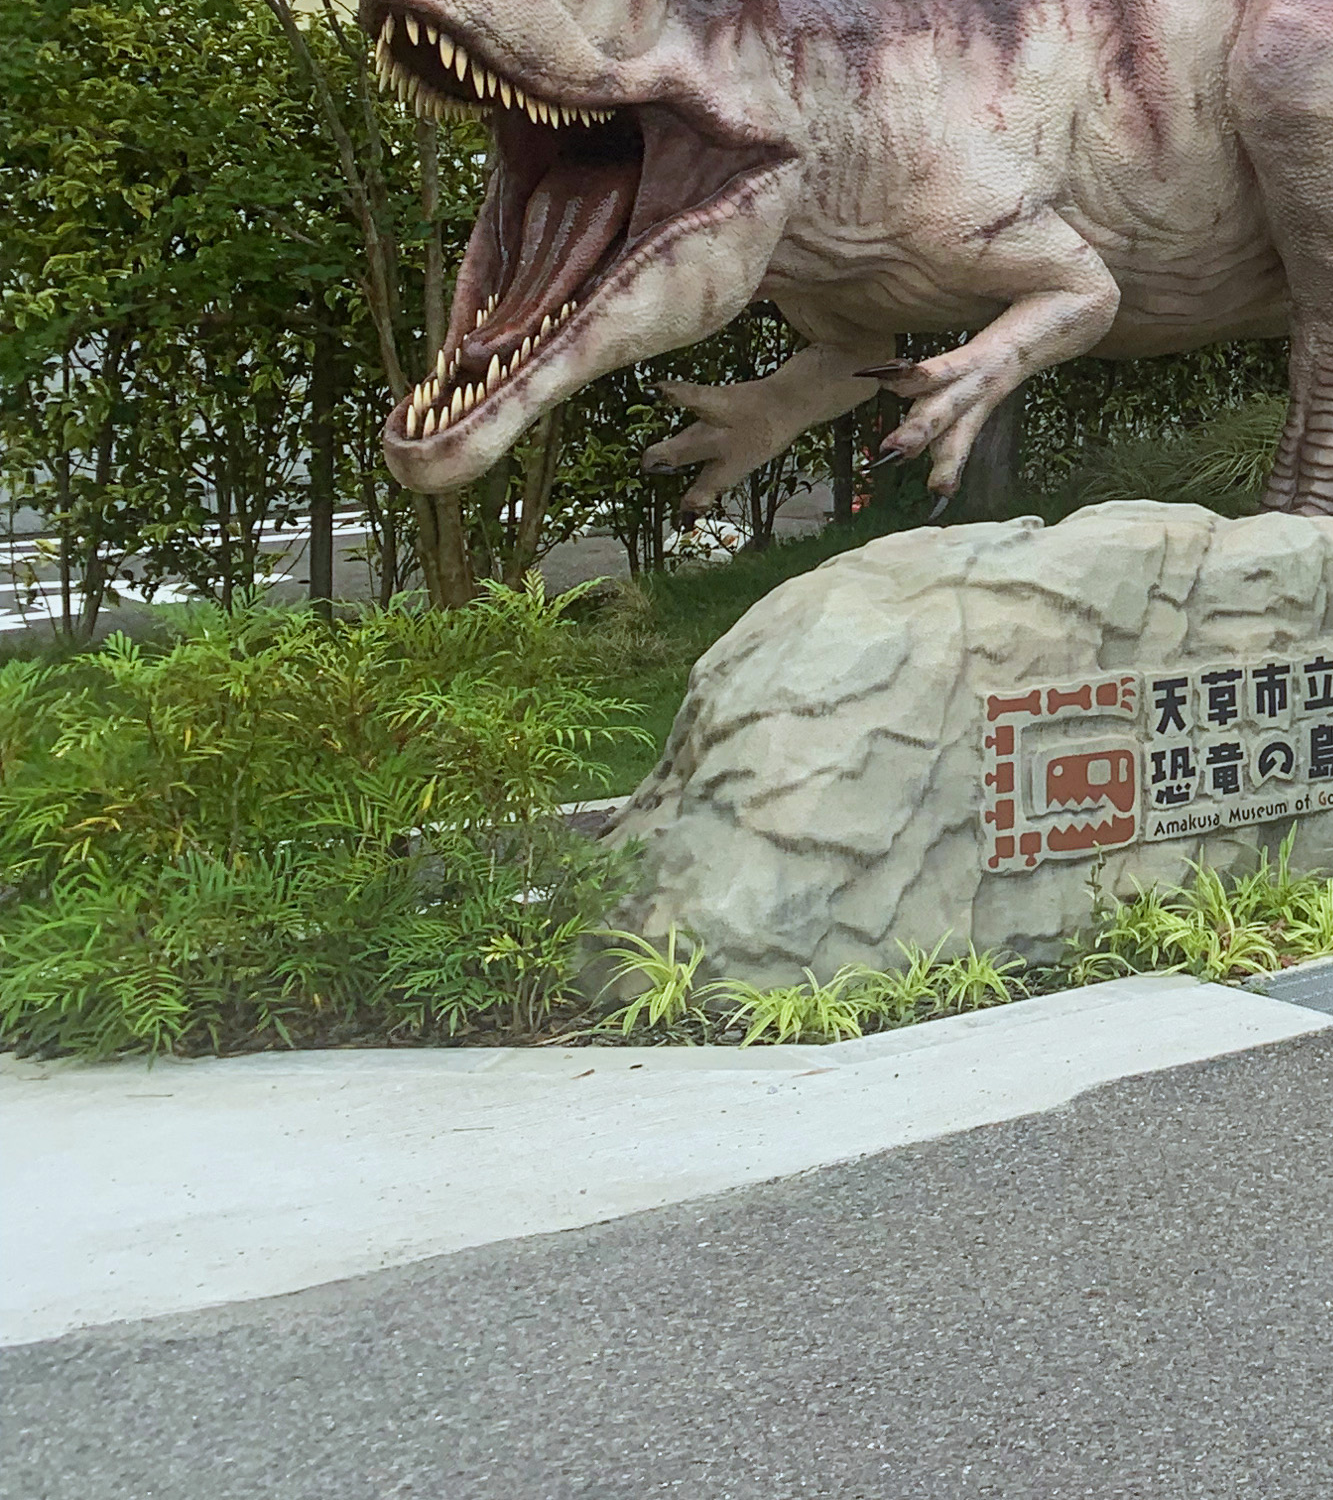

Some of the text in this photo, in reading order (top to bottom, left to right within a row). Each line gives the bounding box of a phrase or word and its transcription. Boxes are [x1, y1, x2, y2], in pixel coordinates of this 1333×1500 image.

[1154, 812, 1220, 836] Amakusa
[1229, 802, 1287, 823] Museum
[1295, 794, 1311, 811] of
